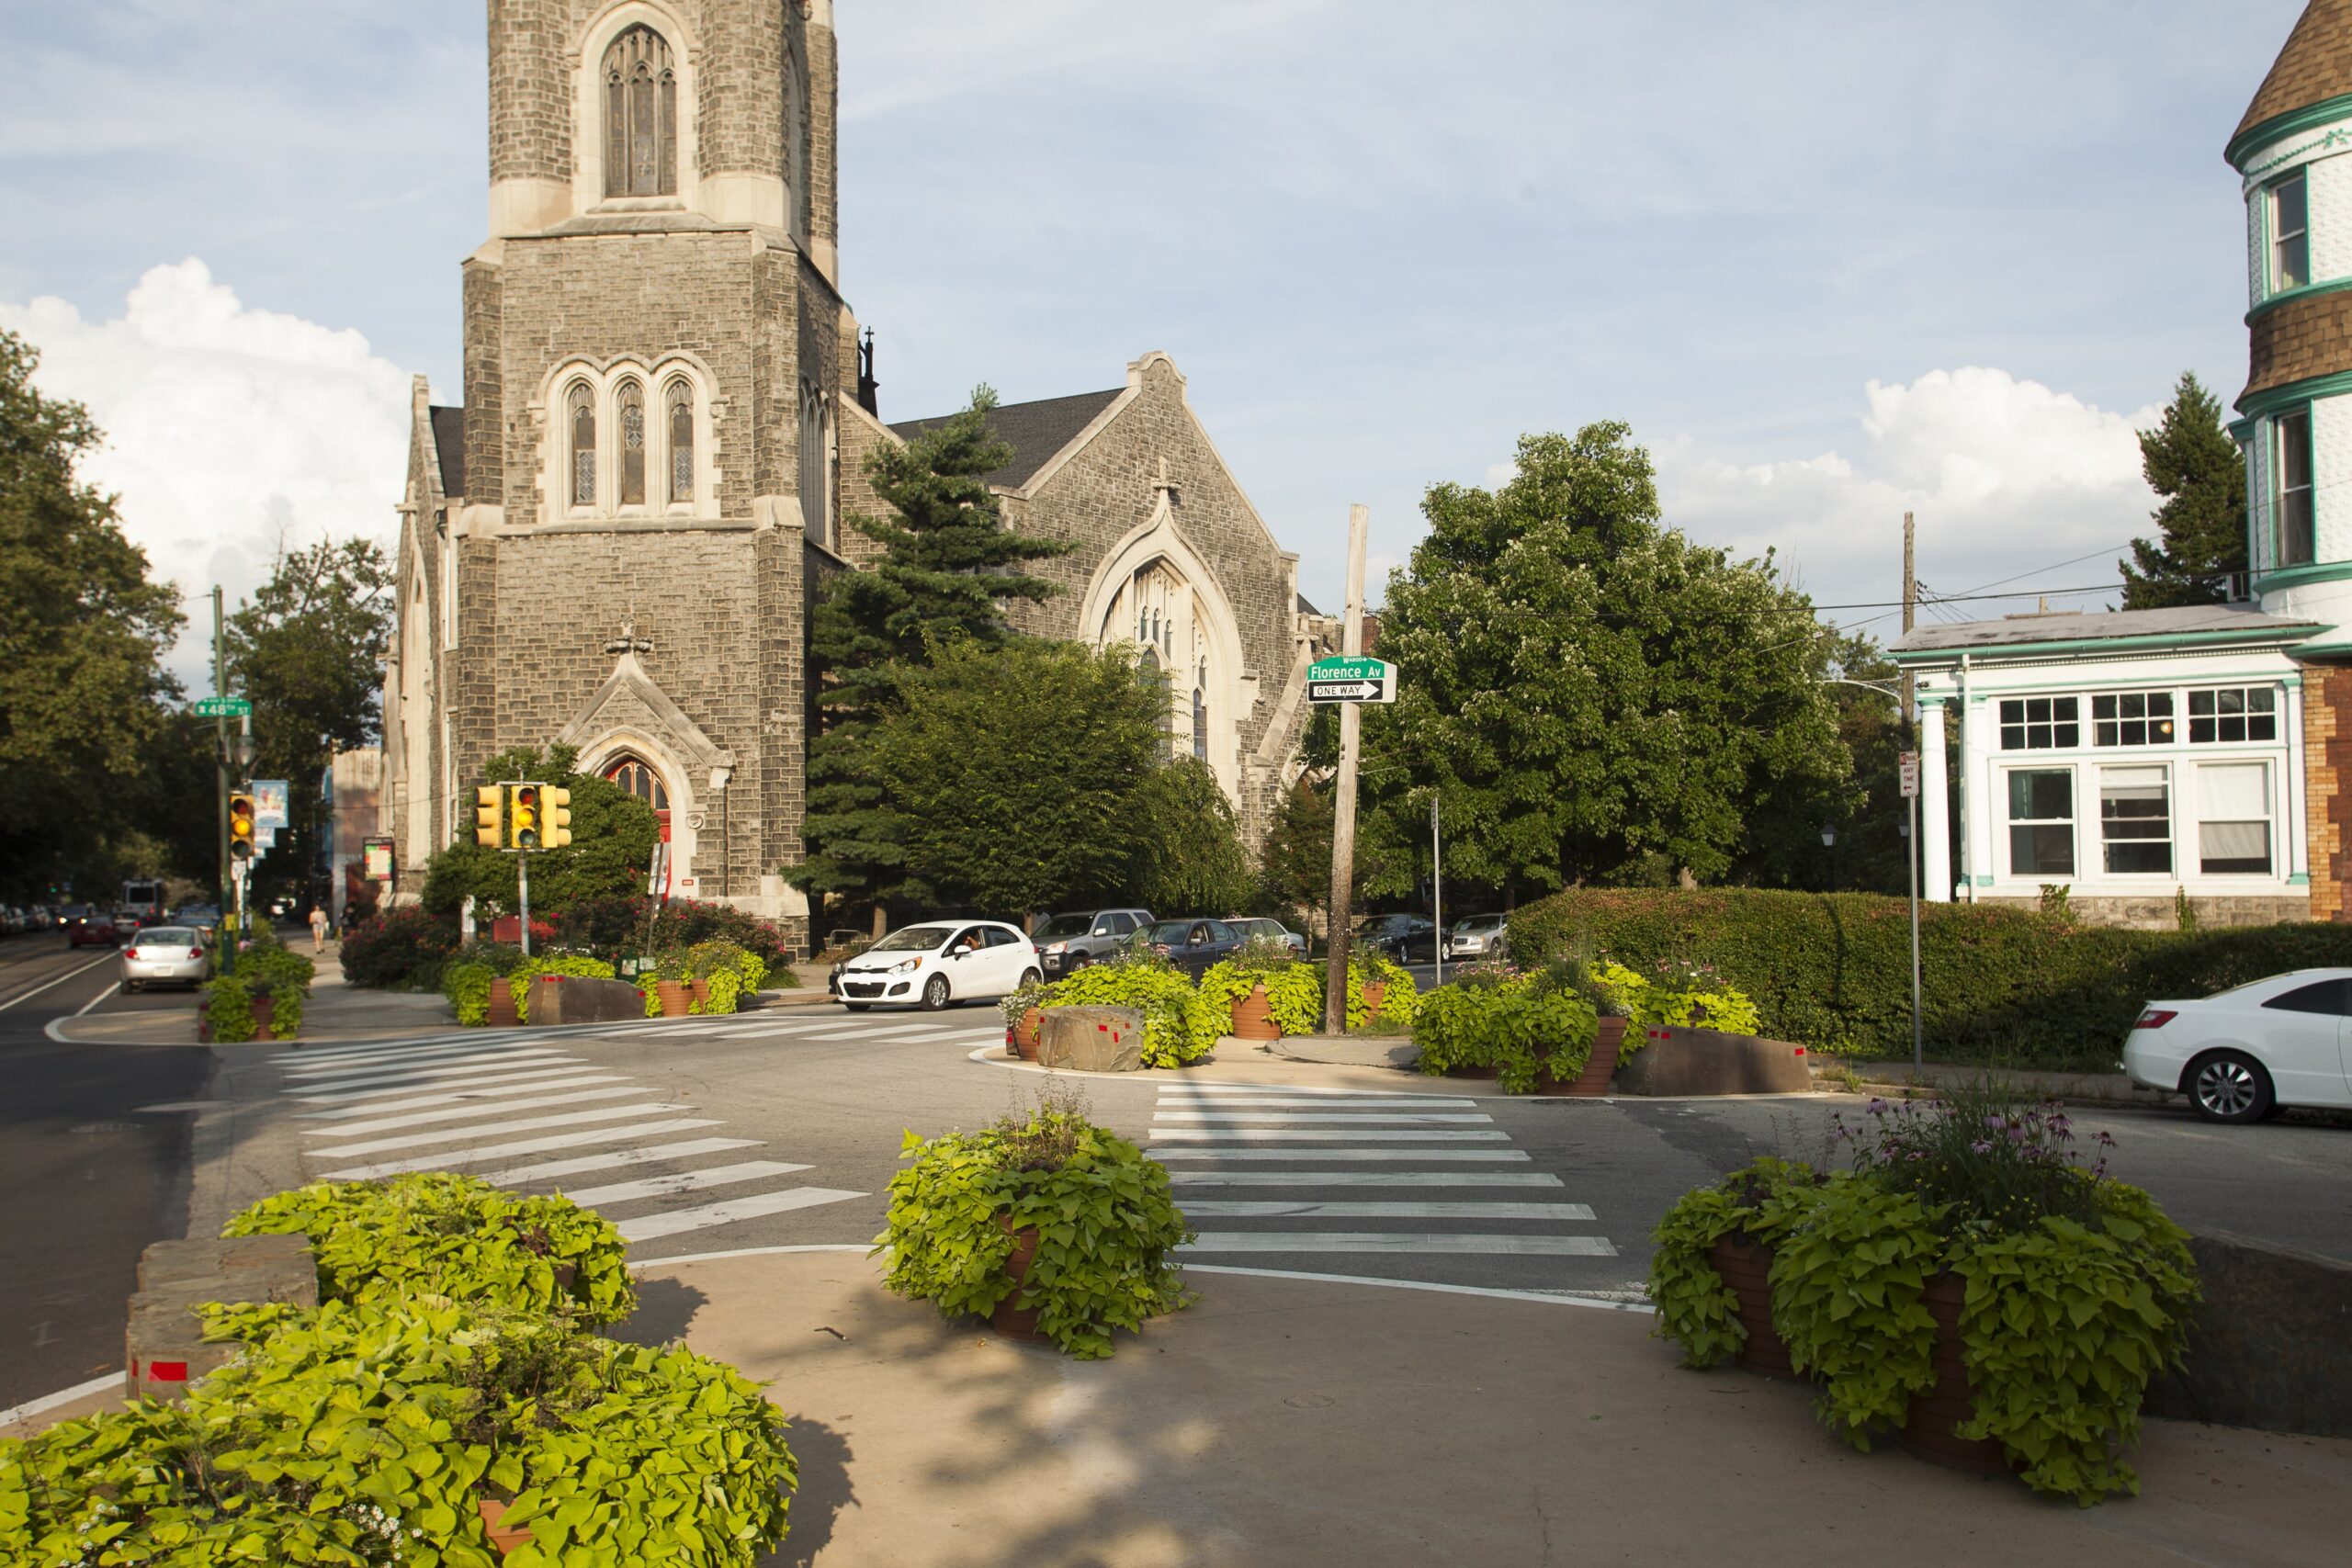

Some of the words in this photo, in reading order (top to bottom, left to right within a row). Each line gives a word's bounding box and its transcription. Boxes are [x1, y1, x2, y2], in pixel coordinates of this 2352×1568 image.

[1311, 666, 1362, 679] Florence
[1368, 666, 1381, 677] Av
[1317, 686, 1337, 695] ONE
[1340, 686, 1361, 695] WAY
